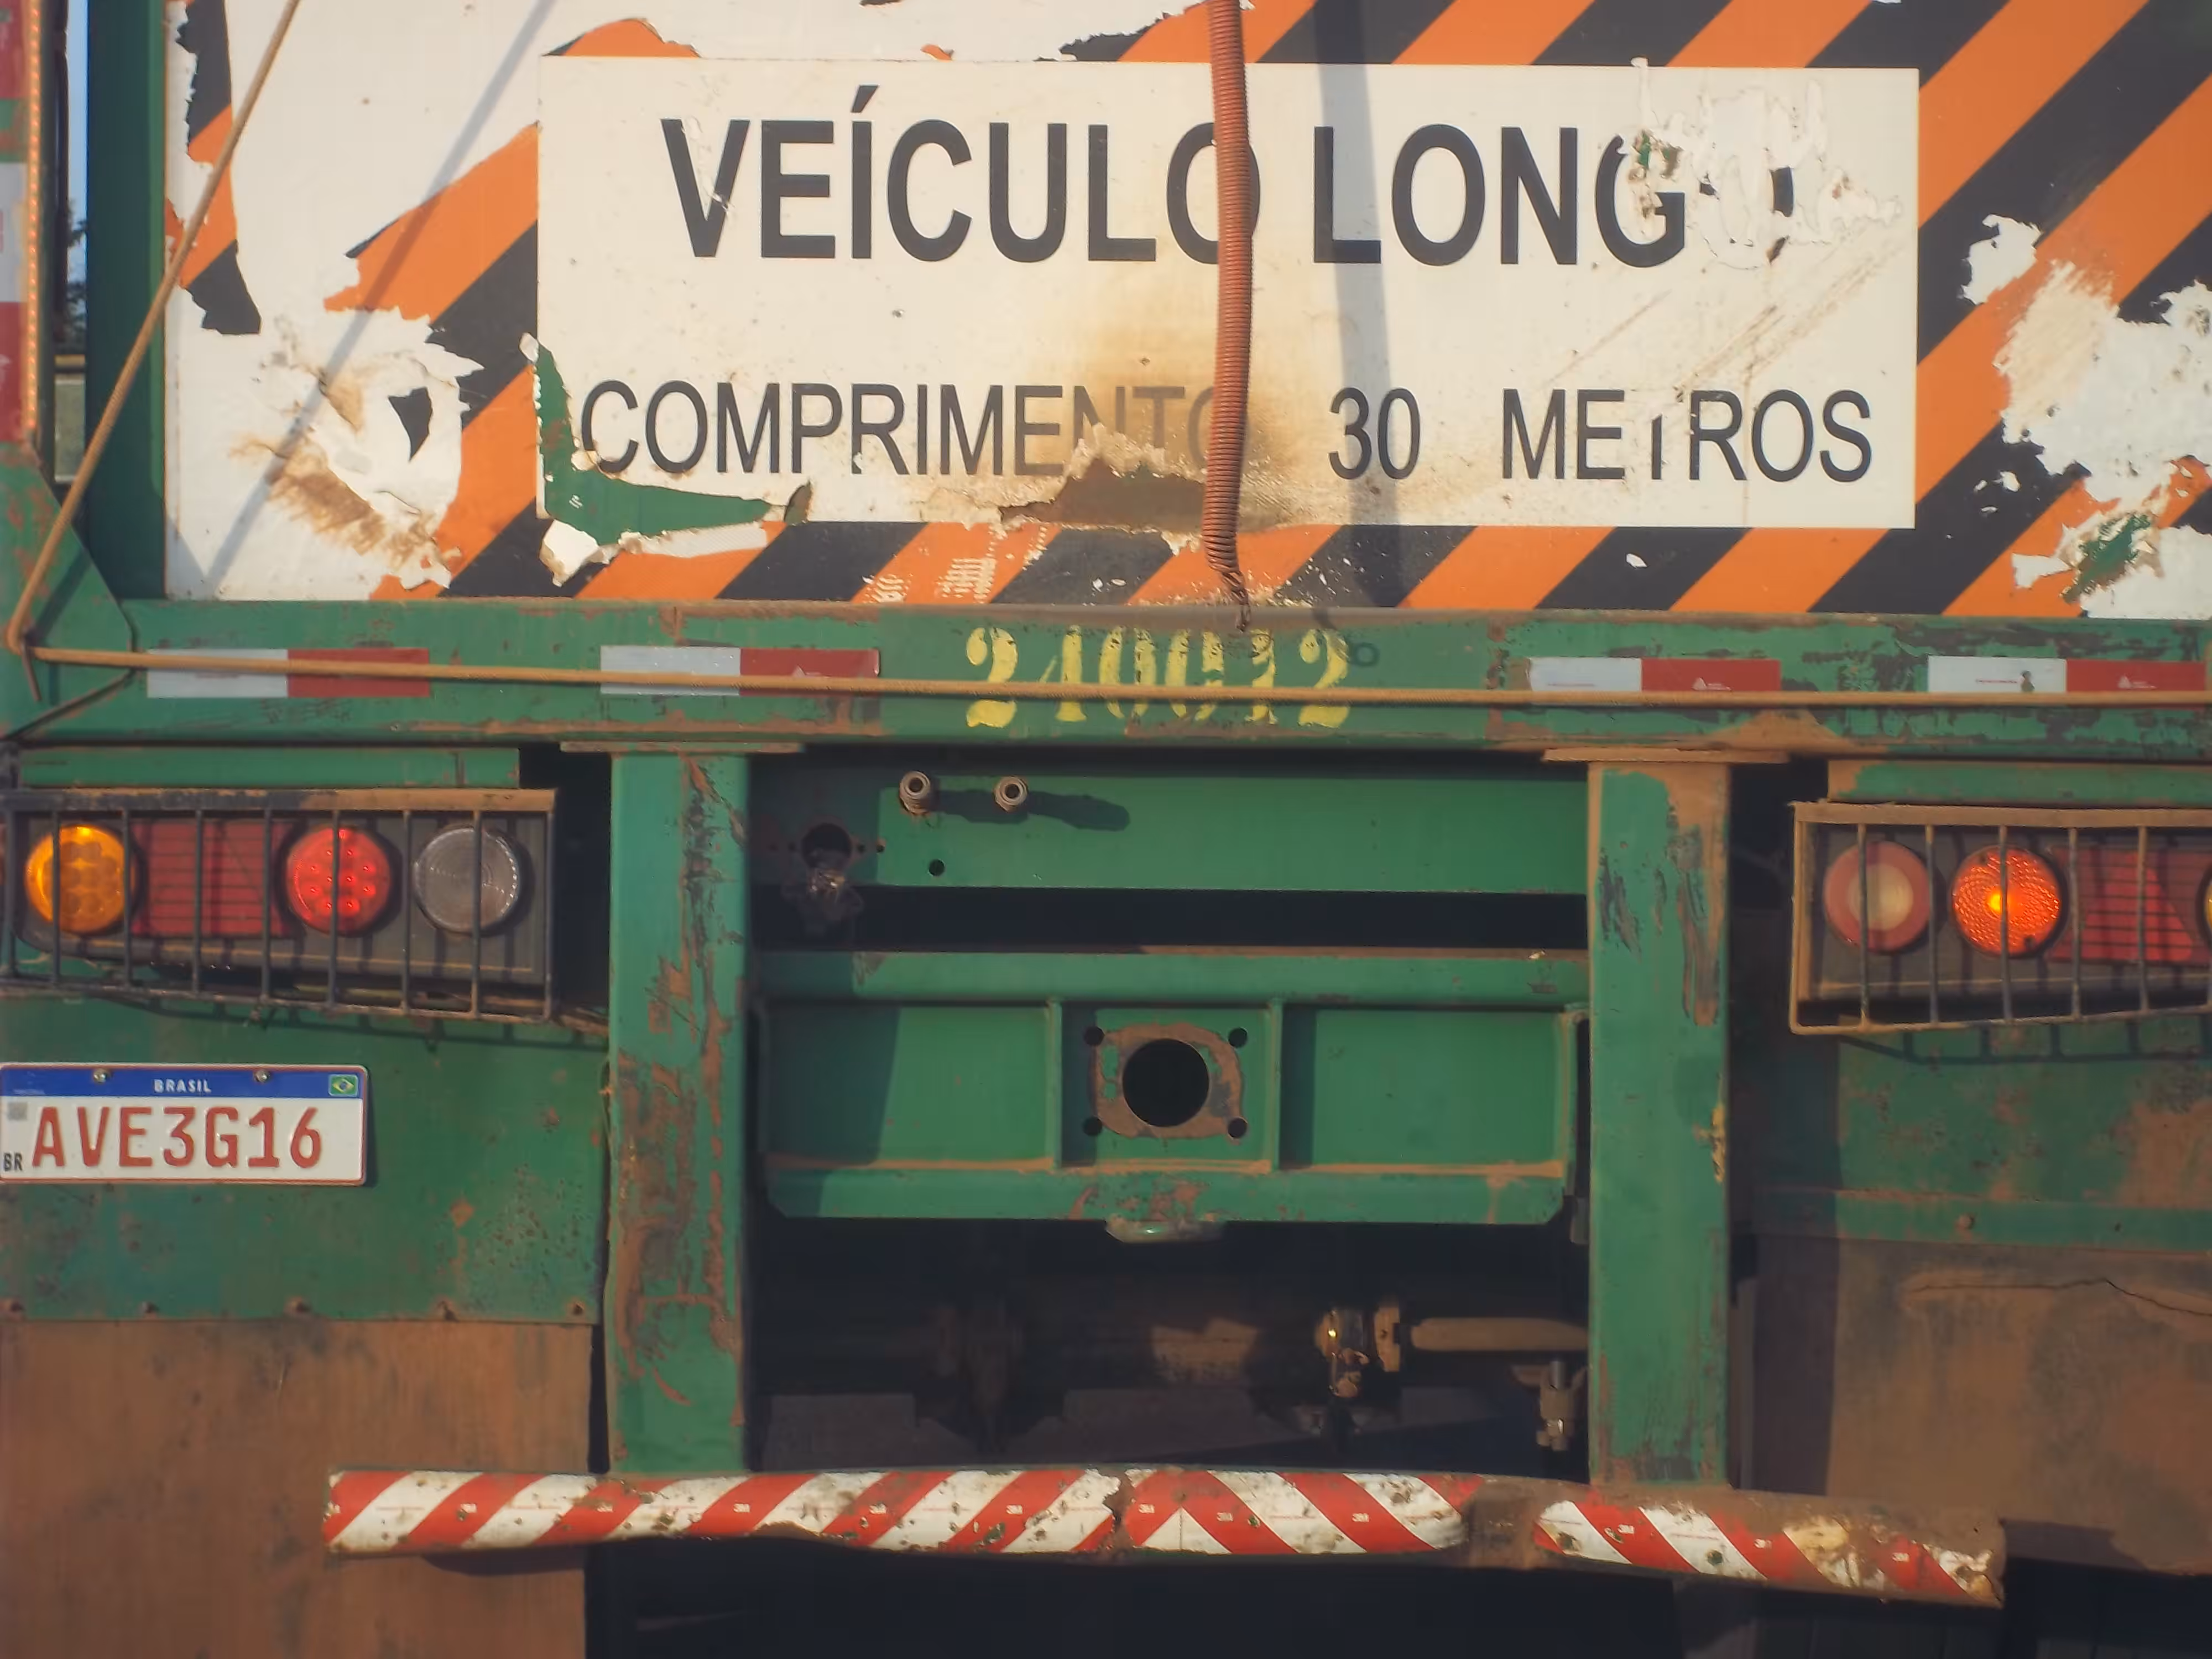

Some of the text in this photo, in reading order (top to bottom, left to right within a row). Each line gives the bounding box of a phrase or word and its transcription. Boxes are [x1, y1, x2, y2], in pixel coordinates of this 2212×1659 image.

[661, 85, 1793, 268] VEÍCULO LONG
[1328, 387, 1421, 480] 30
[154, 1078, 211, 1093] BRASIL
[32, 1106, 321, 1168] AVE3G16
[3, 1152, 23, 1172] BR
[1352, 1512, 1369, 1522] 3M
